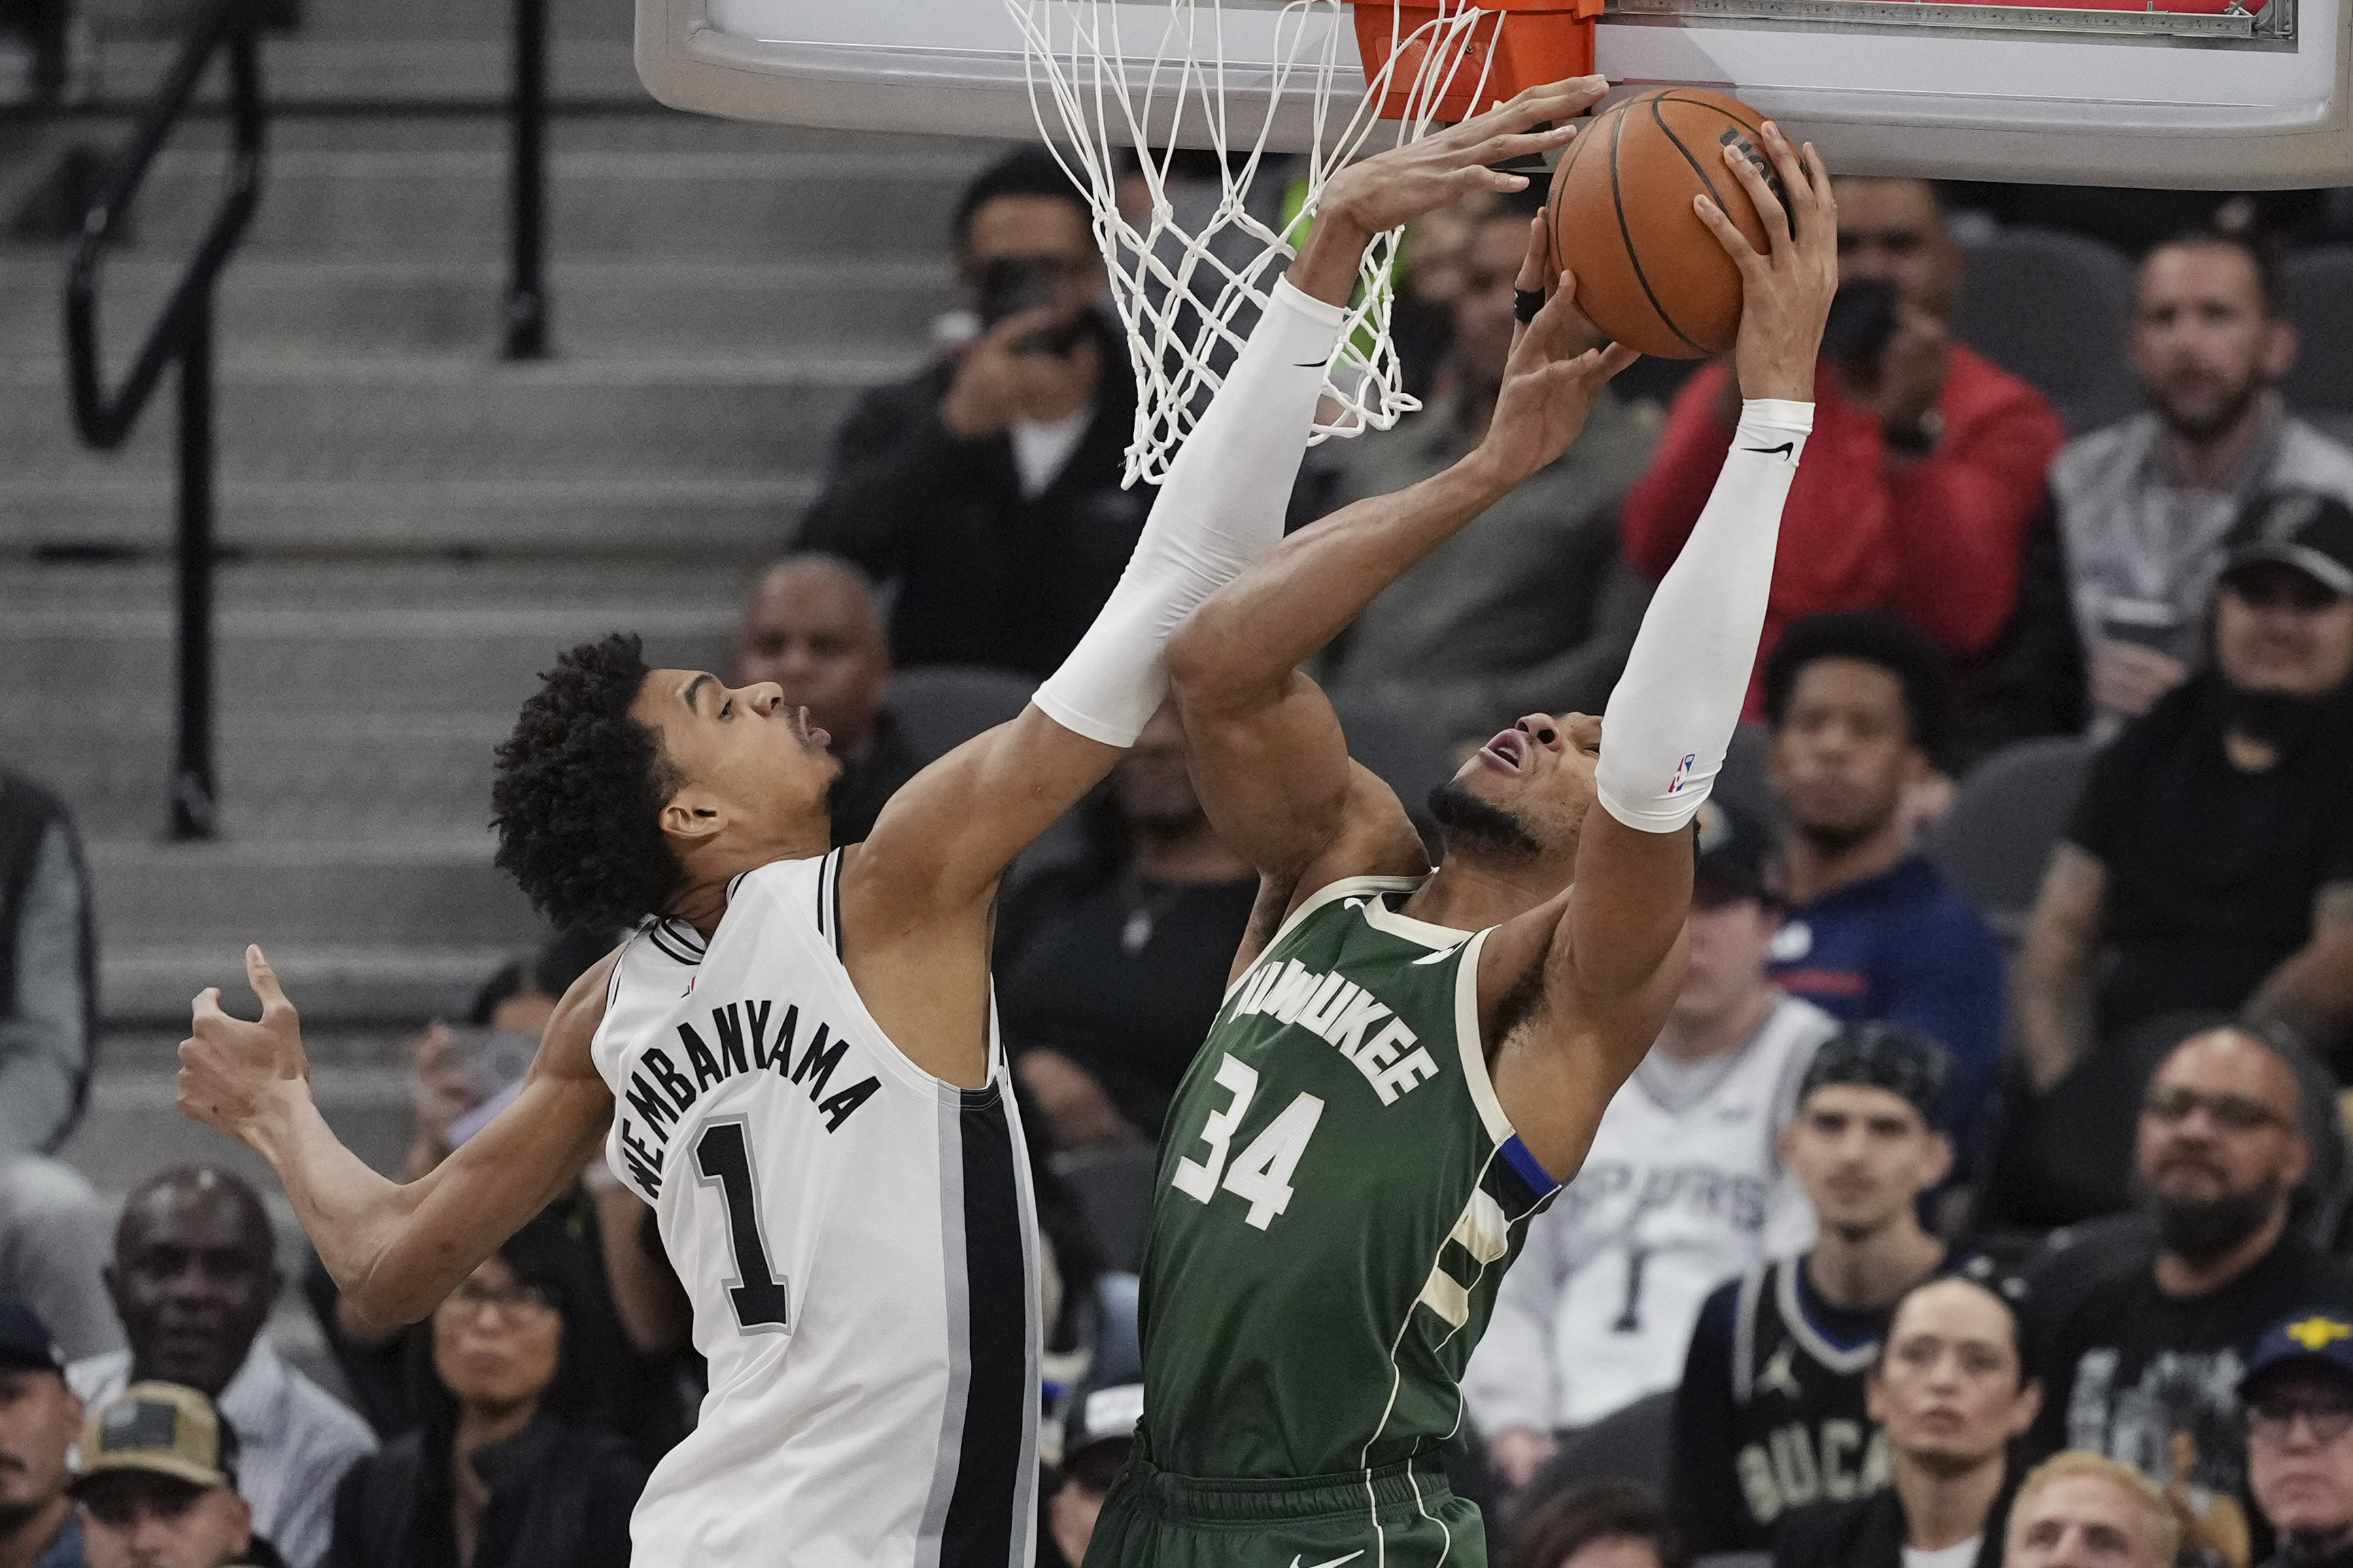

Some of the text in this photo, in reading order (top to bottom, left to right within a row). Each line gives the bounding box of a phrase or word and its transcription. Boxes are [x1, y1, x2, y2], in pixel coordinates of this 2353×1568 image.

[621, 1000, 882, 1200] WEMBANYAMA
[1171, 1051, 1326, 1232] 34
[686, 1112, 792, 1337] 1
